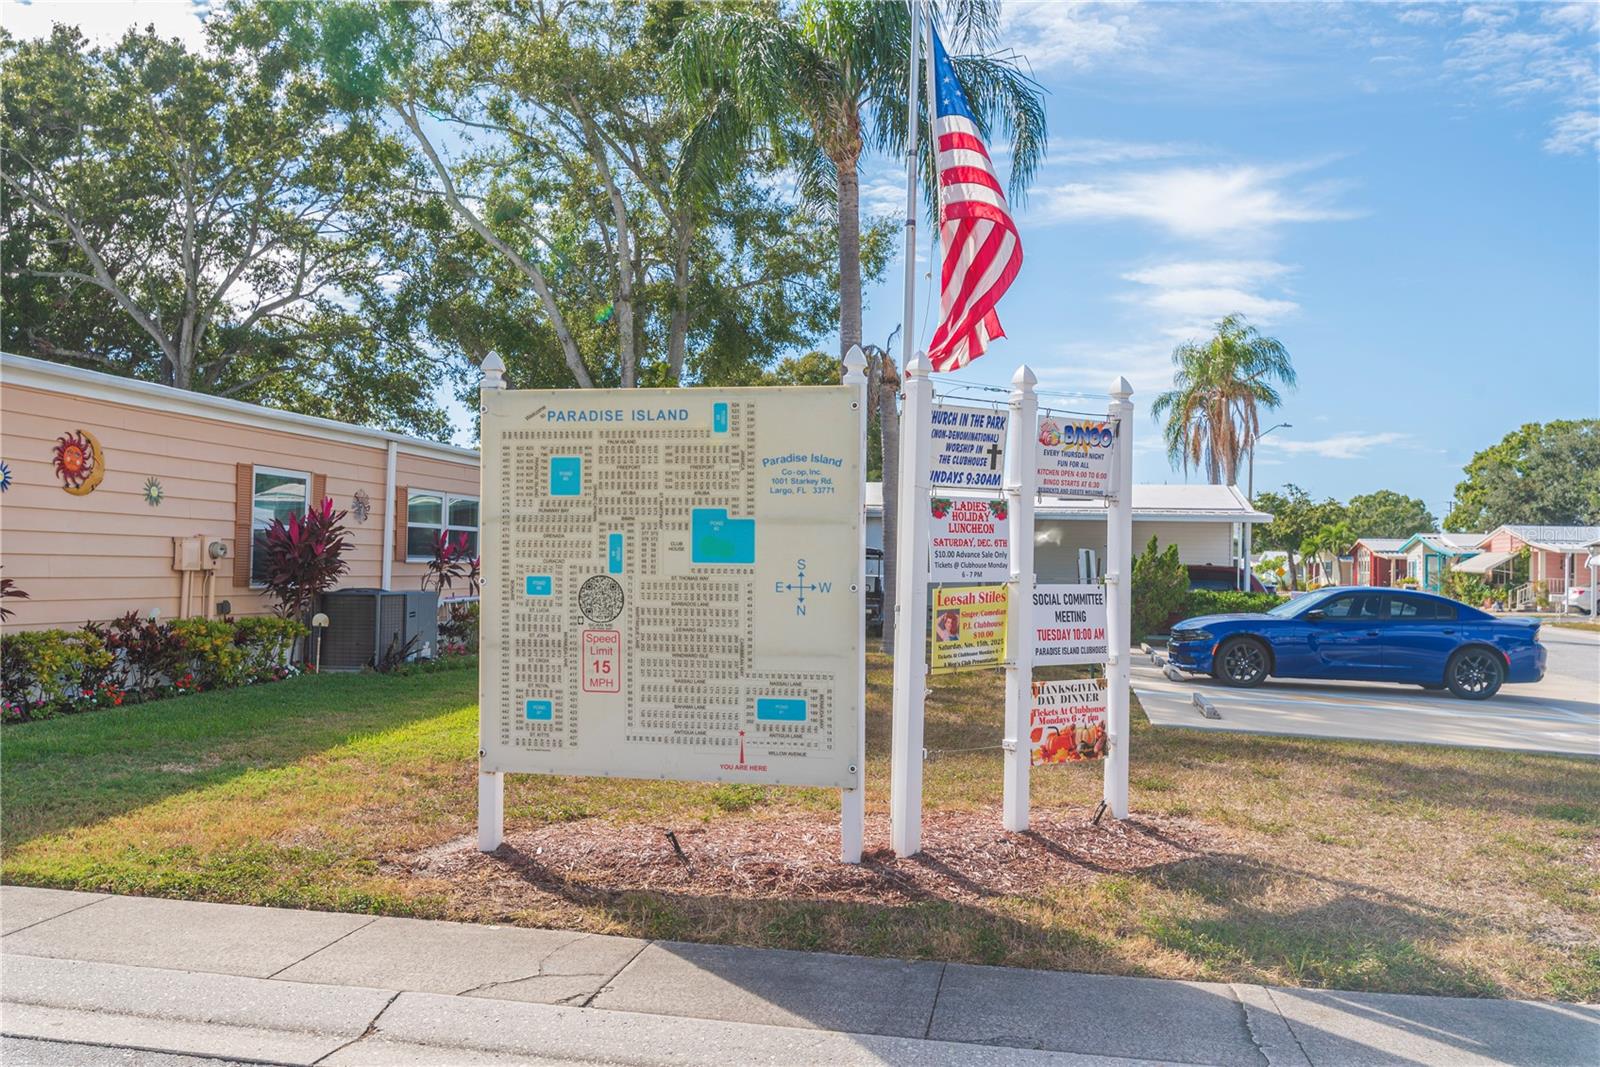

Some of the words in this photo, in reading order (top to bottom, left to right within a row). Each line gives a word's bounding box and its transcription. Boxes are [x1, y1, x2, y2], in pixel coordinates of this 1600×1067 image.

[547, 410, 624, 422] PARADISE
[632, 409, 688, 421] ISLAND
[931, 410, 958, 426] HURCH
[959, 413, 969, 427] IN
[970, 414, 985, 428] THE
[986, 415, 1006, 430] PARK
[931, 428, 1000, 443] (NON-DENOMINATIONAL)
[1064, 424, 1112, 448] BINGO
[946, 442, 974, 453] WORSHIP
[975, 445, 984, 454] IN
[1043, 448, 1060, 456] EVERY
[1061, 450, 1088, 458] THURSDAY
[762, 454, 807, 468] Paradise
[811, 453, 842, 468] Island
[939, 454, 951, 464] THE
[952, 456, 988, 467] CLUBHOUSE
[791, 478, 819, 486] Starkey
[930, 470, 964, 484] NDAYS
[966, 472, 1001, 486] 9:30AM
[954, 501, 987, 511] LADIES
[952, 512, 991, 522] HOLIDAY
[948, 523, 994, 534] LUNCHEON
[933, 538, 976, 548] SATURDAY,
[977, 539, 993, 547] DEC.
[934, 550, 955, 558] $10.00
[994, 551, 1007, 559] Only
[797, 559, 806, 570] S
[775, 582, 783, 592] E
[818, 582, 832, 592] W
[937, 591, 975, 607] Leesah
[978, 590, 1006, 604] Stiles
[1033, 593, 1061, 606] SOCIAL
[1063, 593, 1103, 605] COMMITTEE
[797, 605, 806, 616] N
[1055, 610, 1087, 623] MEETING
[586, 634, 617, 644] Speed
[1037, 629, 1071, 641] TUESDAY
[1073, 628, 1092, 640] 10:00
[1094, 628, 1105, 640] AM
[590, 646, 613, 655] Limit
[1035, 647, 1061, 656] PARADISE
[1080, 646, 1107, 654] CLUBHOUSE
[592, 660, 611, 674] 15
[590, 678, 613, 687] MPH
[1038, 696, 1056, 705] DAY
[1061, 693, 1099, 704] DINNER
[1032, 708, 1058, 717] Tickets
[1070, 705, 1106, 715] Clubhouse
[1038, 716, 1070, 725] Mondays
[1082, 714, 1086, 722] 7
[1088, 714, 1099, 724] pm
